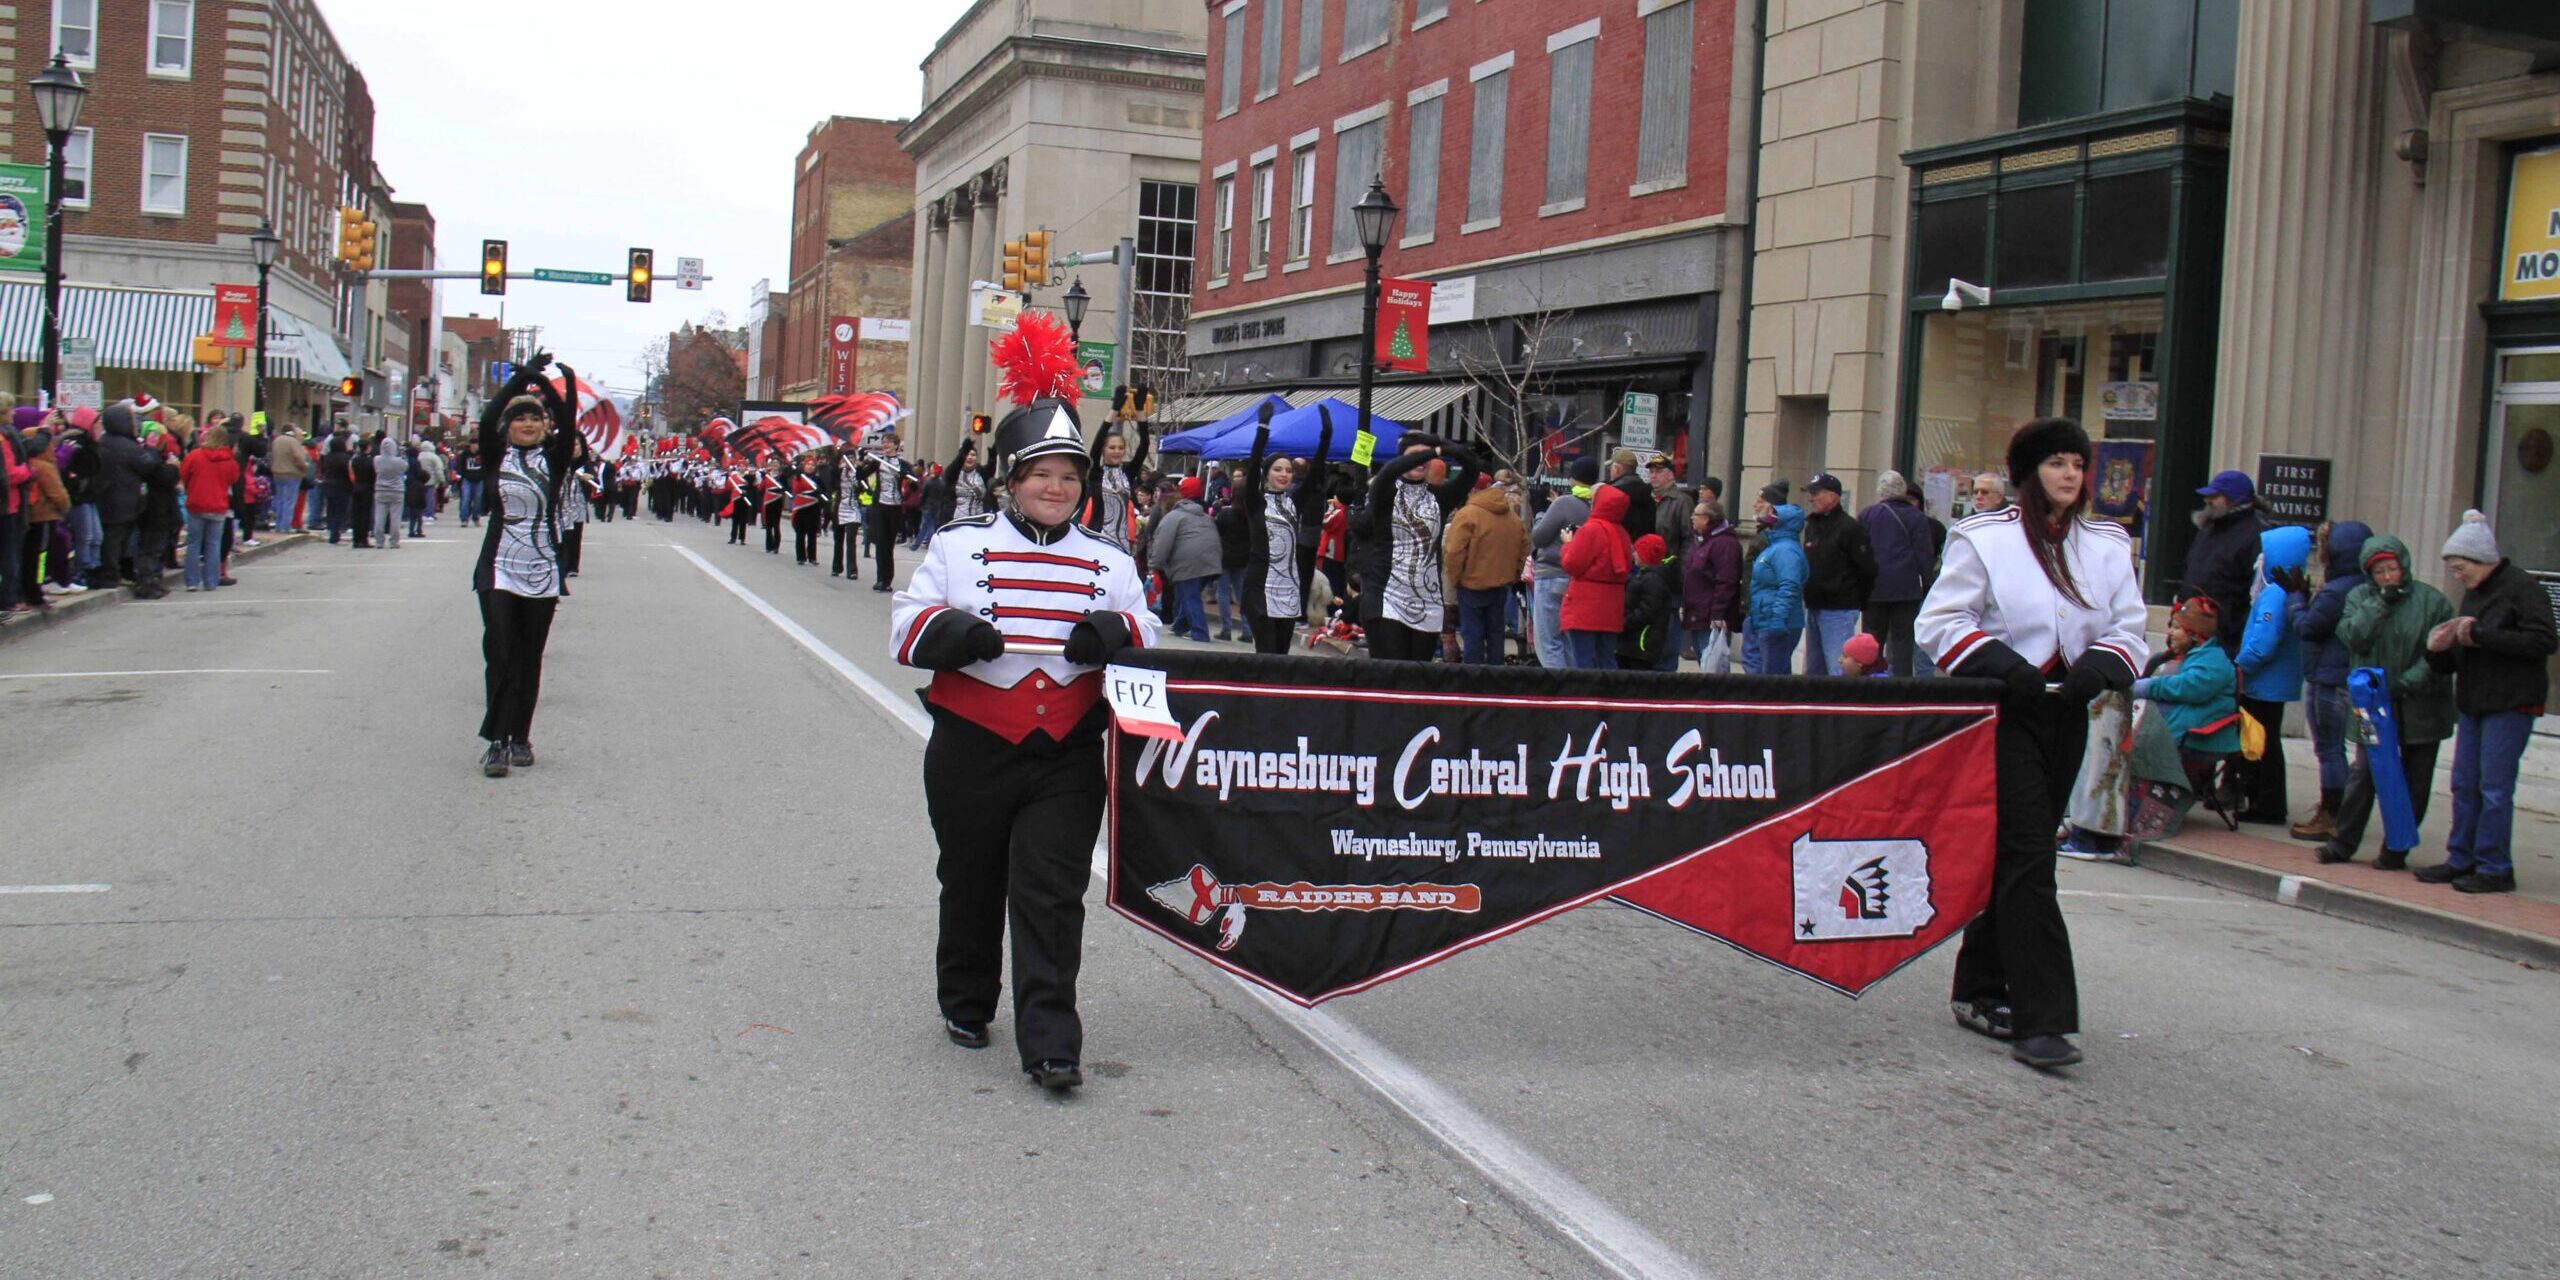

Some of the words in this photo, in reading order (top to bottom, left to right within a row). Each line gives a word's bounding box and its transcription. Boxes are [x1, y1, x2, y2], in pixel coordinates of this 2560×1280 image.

[1392, 288, 1419, 300] Happy
[1386, 296, 1423, 307] Holidays
[1626, 396, 1634, 411] 2
[1633, 417, 1648, 425] THIS
[1627, 426, 1650, 434] BLOCK
[2276, 465, 2316, 479] FIRST
[2265, 483, 2322, 498] FEDERAL
[2272, 502, 2321, 516] AVINGS
[1115, 679, 1156, 709] F12
[1135, 710, 1377, 807] Waynesburg
[1393, 725, 1528, 810] Central
[1548, 720, 1650, 811] High
[1666, 728, 1776, 808] School
[1331, 829, 1461, 863] Waynesburg,
[1467, 832, 1601, 864] Pennsylvania
[1257, 890, 1375, 904] RAIDER
[1380, 891, 1457, 905] BAND
